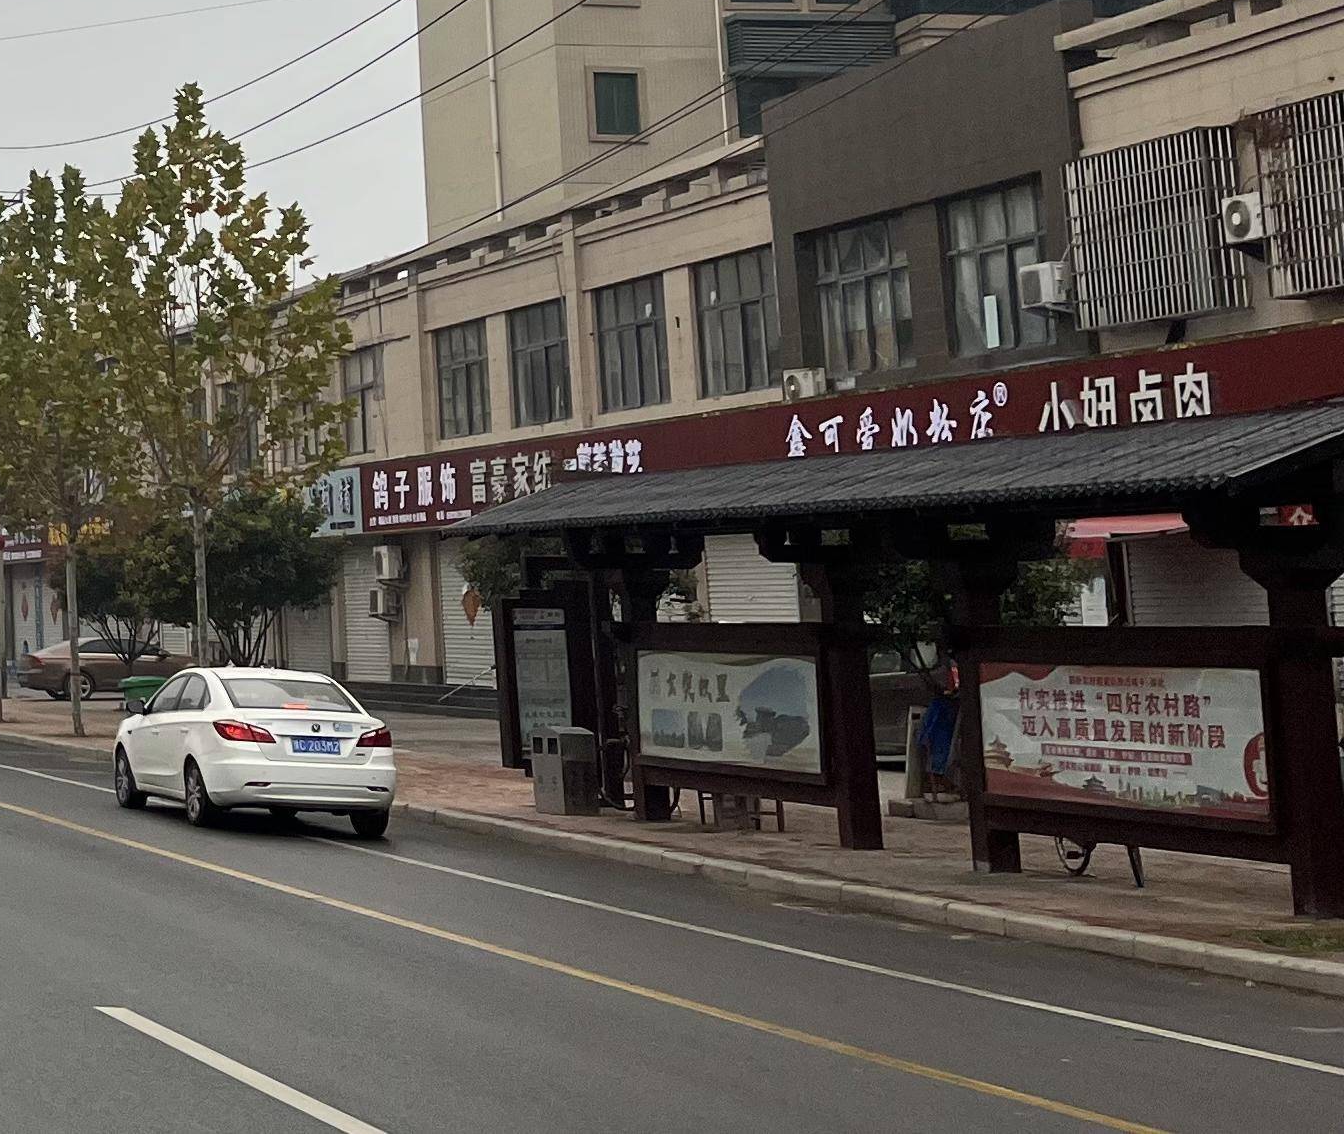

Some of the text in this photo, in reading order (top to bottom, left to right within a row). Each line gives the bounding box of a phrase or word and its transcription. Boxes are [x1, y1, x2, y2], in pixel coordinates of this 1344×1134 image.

[371, 461, 457, 511] 鸽子服饰
[1021, 714, 1227, 750] 迈入高质量发展的新阶段
